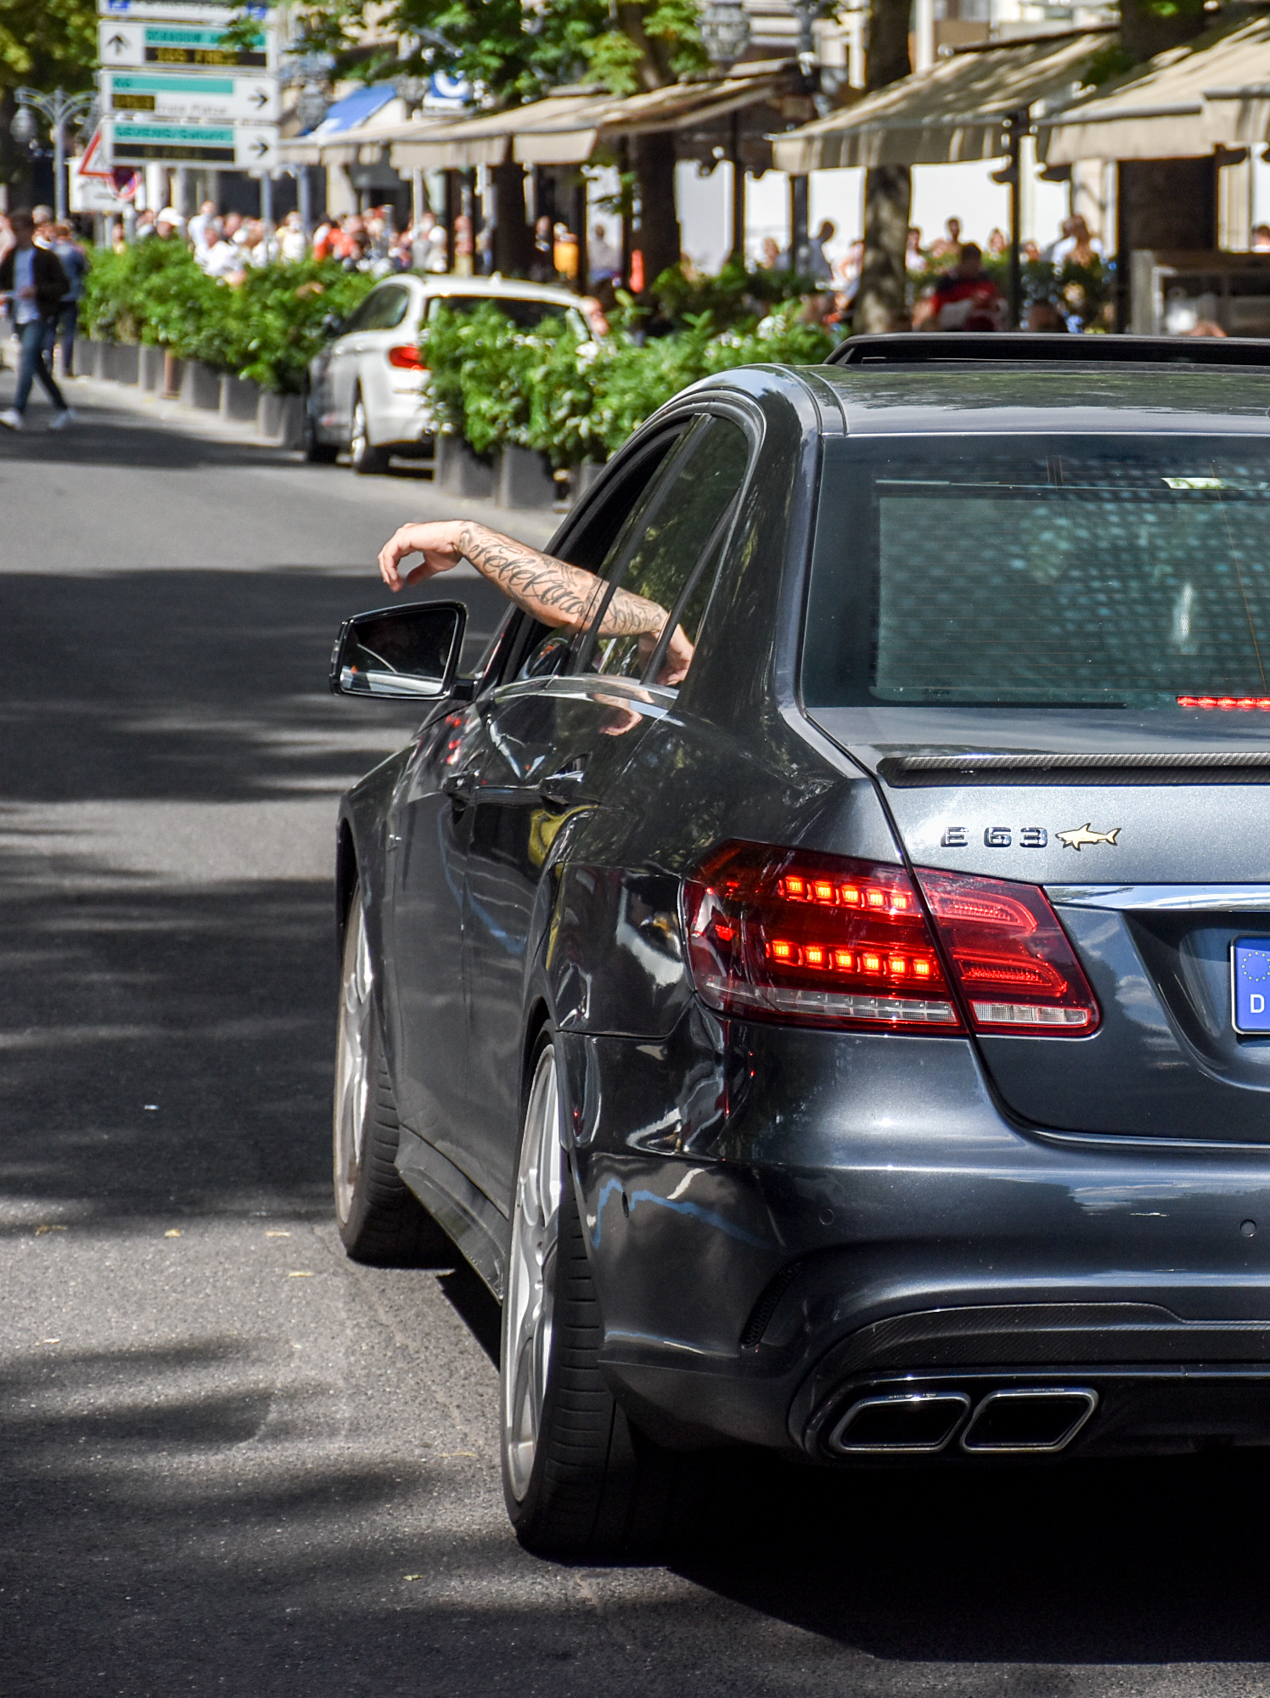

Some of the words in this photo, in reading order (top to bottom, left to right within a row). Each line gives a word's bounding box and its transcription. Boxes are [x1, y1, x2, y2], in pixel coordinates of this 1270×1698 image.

[940, 826, 969, 848] E
[983, 826, 1048, 848] 63
[1250, 994, 1265, 1014] D
